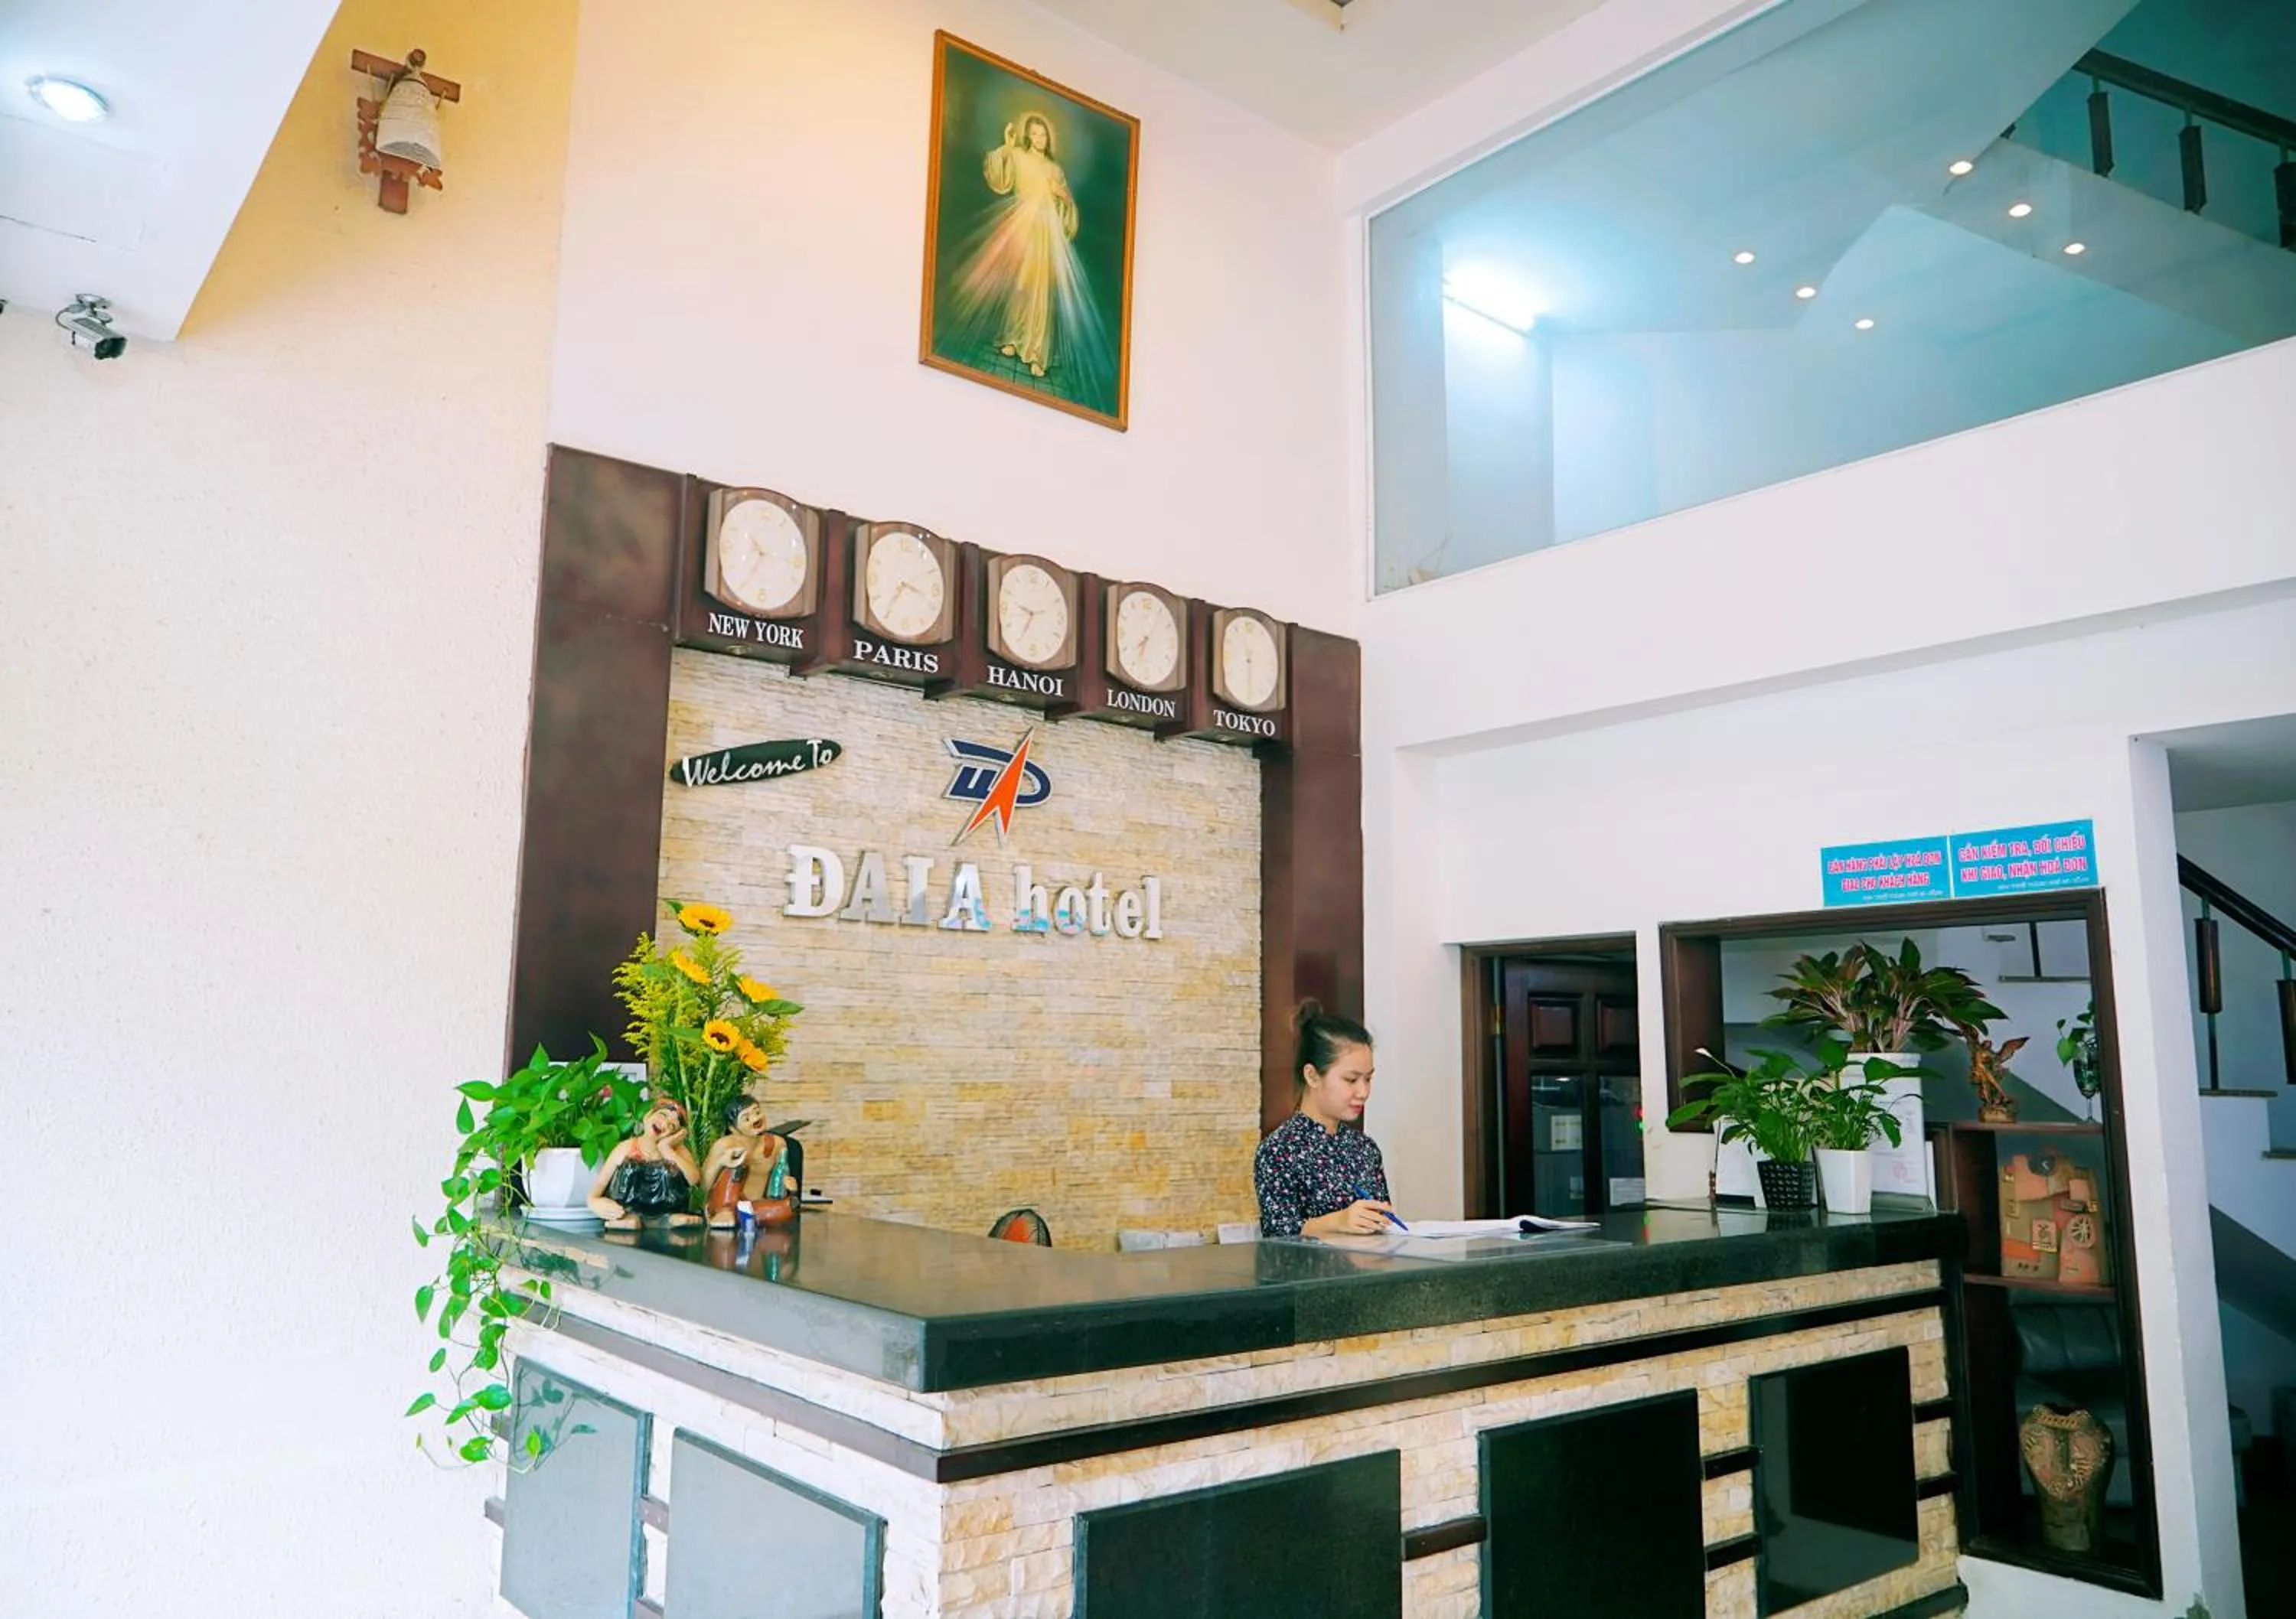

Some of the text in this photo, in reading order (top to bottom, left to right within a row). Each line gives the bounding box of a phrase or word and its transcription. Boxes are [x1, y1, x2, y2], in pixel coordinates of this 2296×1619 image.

[708, 612, 804, 650] NEW YORK
[853, 640, 939, 674] PARIS
[987, 665, 1065, 697] HANOI
[1107, 689, 1176, 718] LONDON
[1213, 710, 1276, 737] TOKYO
[682, 739, 833, 788] Welcome To
[1012, 865, 1163, 940] hotel
